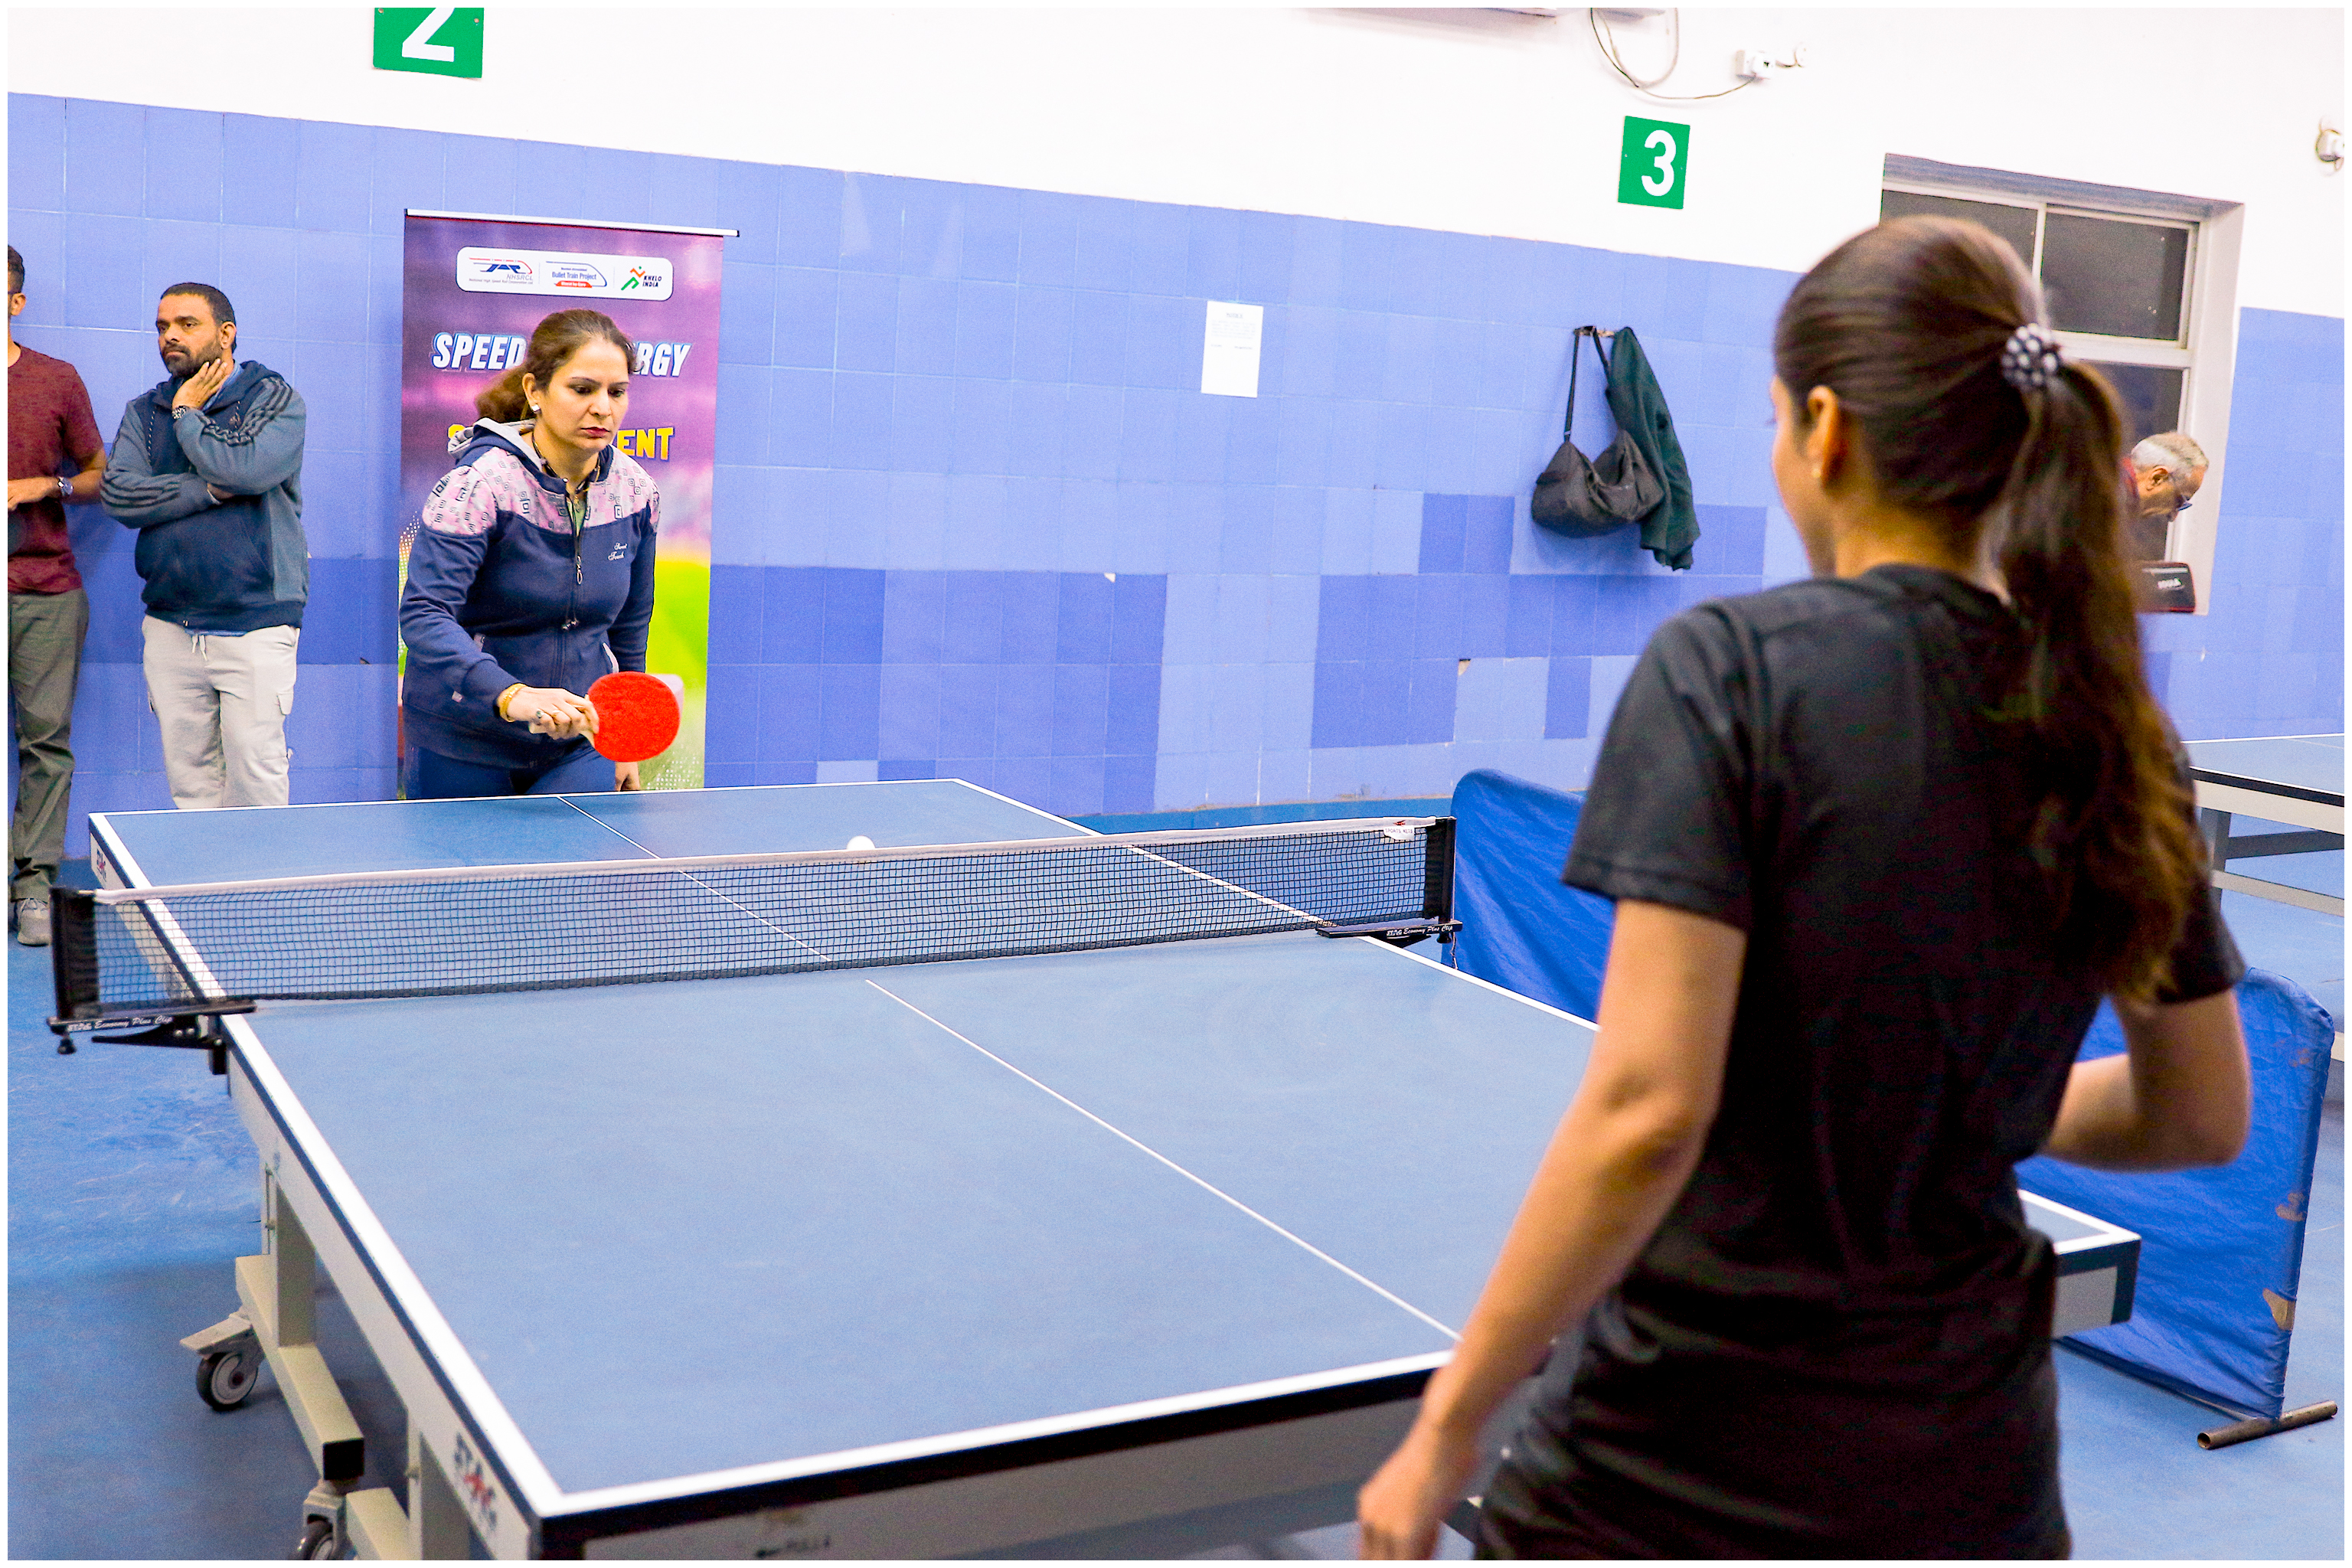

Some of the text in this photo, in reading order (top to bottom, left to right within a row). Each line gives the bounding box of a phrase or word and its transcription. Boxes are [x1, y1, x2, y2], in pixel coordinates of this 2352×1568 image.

[402, 8, 454, 62] 2
[1642, 129, 1676, 196] 3
[580, 273, 596, 281] Project
[431, 332, 527, 370] SPEED
[94, 1020, 129, 1029] Economy
[132, 1017, 152, 1025] Plus
[155, 1014, 174, 1024] Clip
